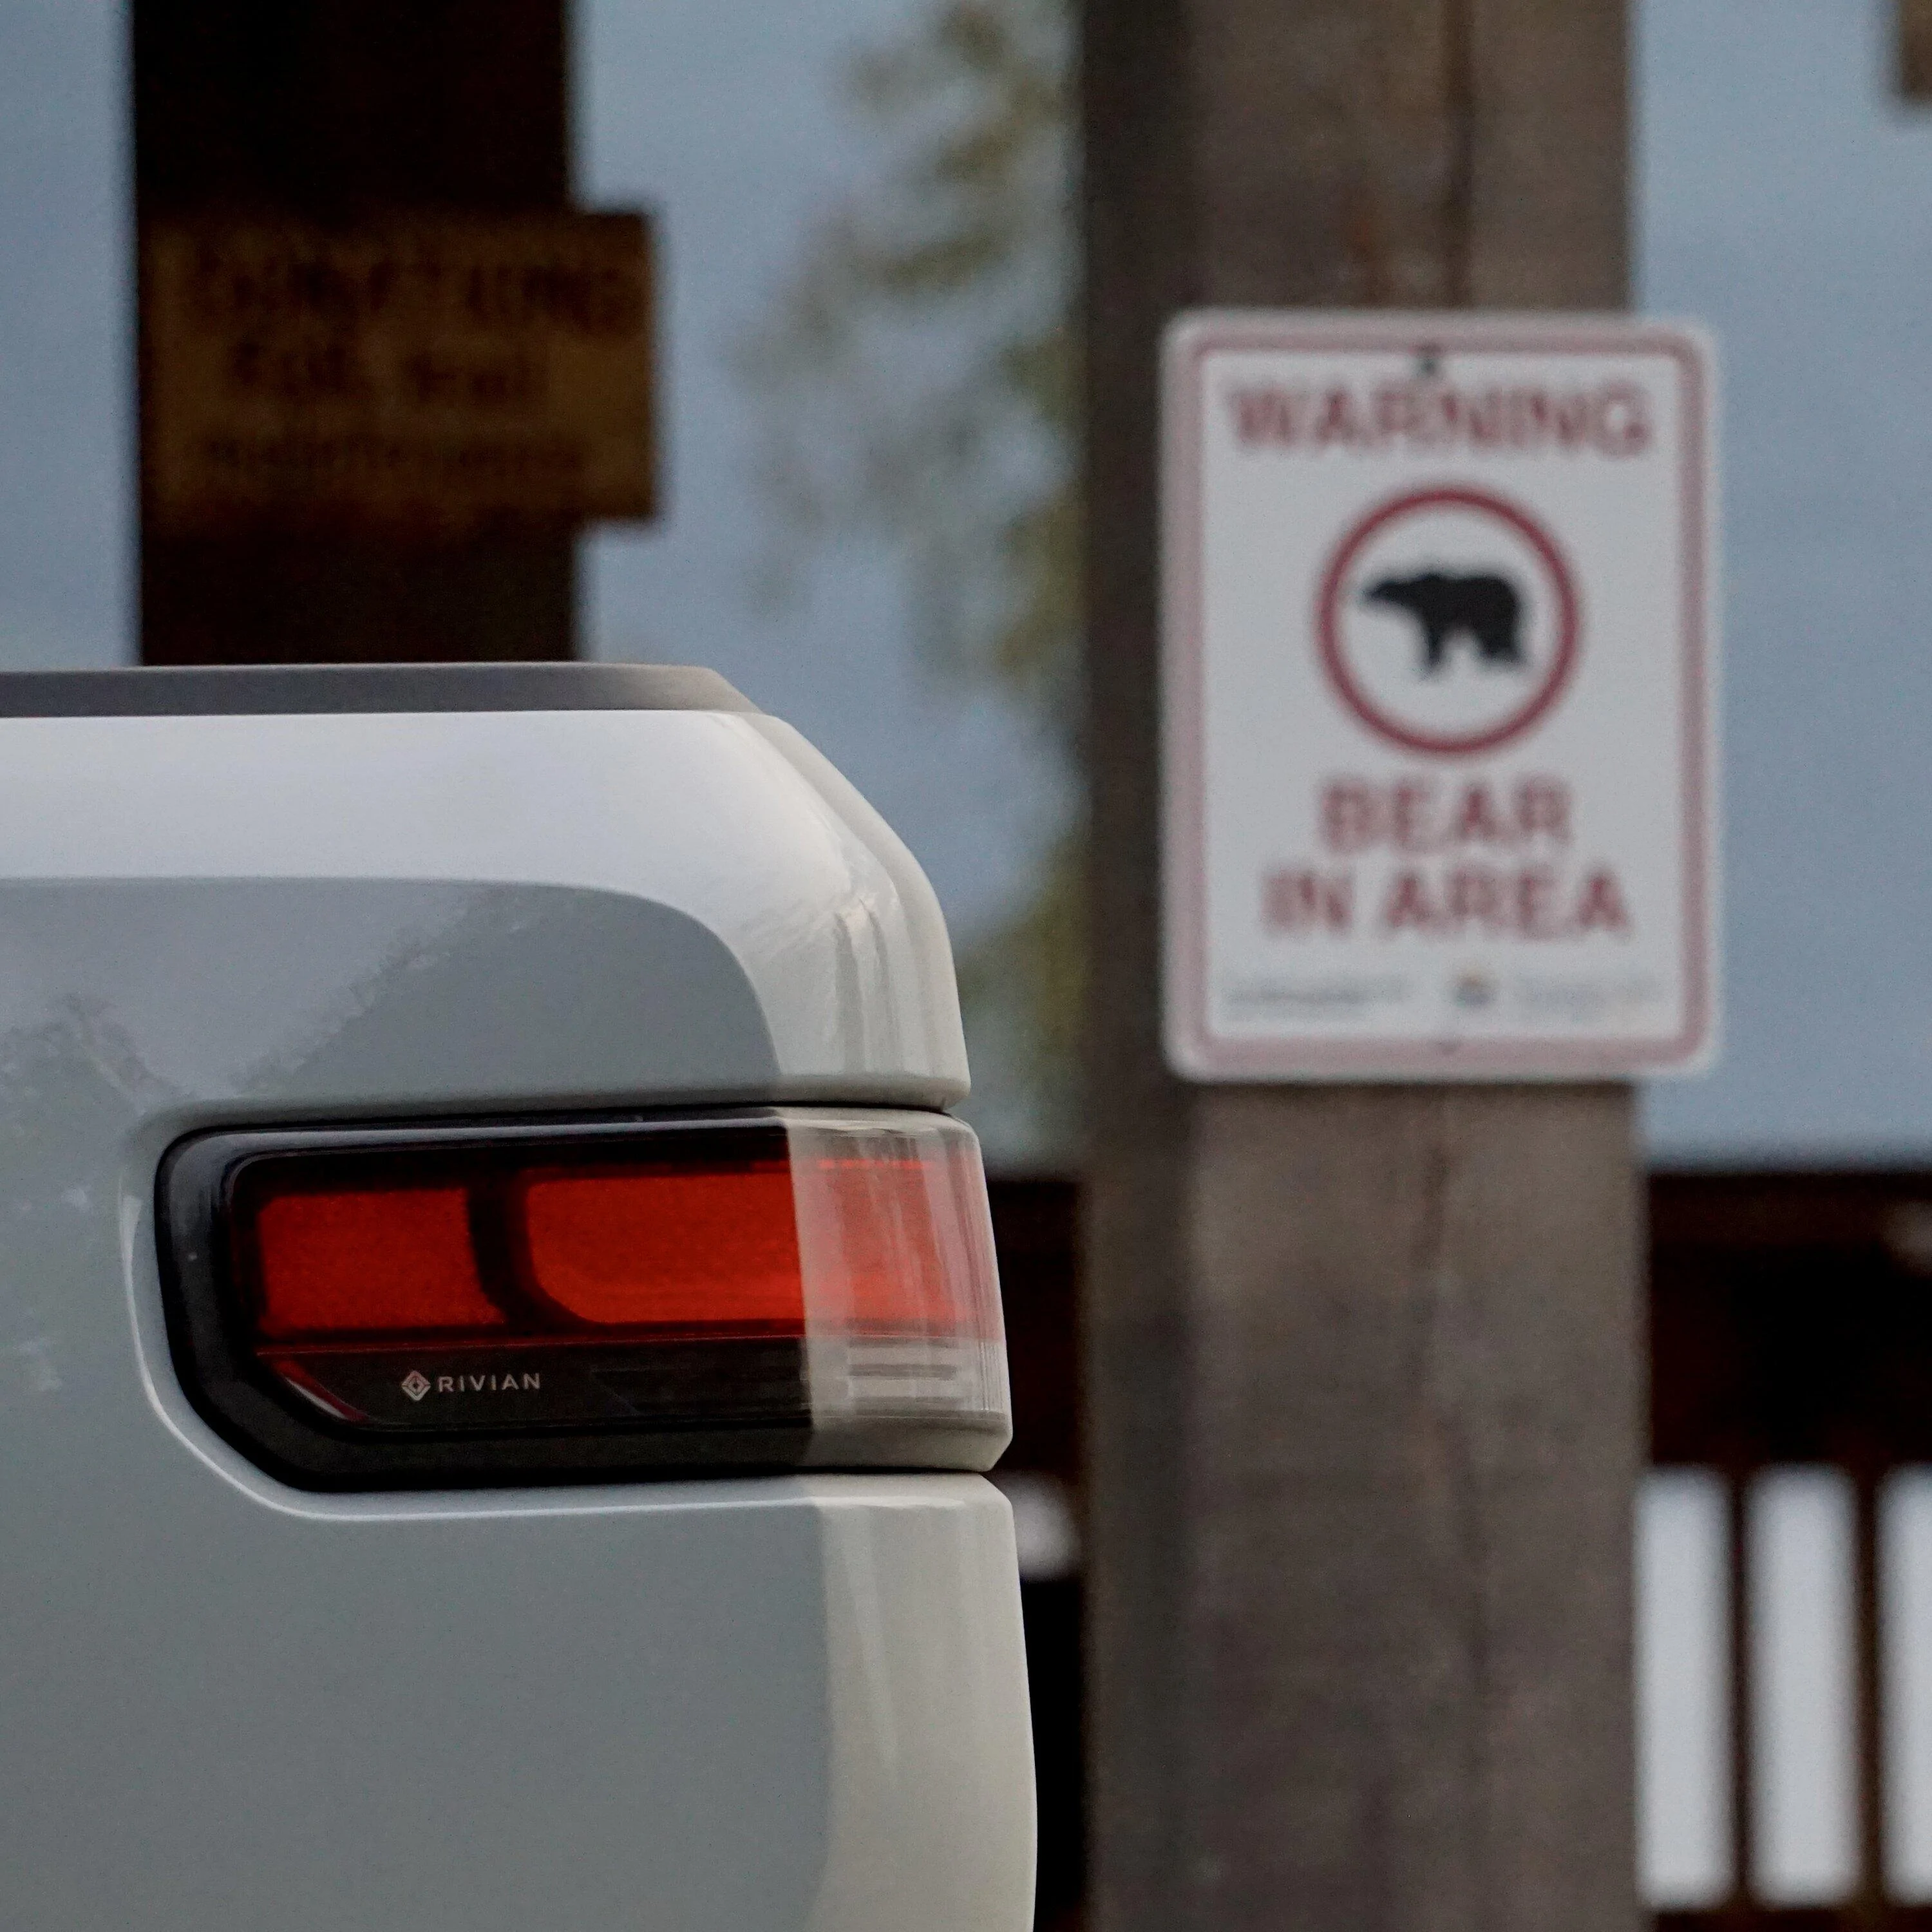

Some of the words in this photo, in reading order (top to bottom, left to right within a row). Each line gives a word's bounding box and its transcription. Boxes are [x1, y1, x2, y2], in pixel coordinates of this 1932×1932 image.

[1231, 383, 1650, 455] WARNING
[1317, 775, 1573, 851] BEAR
[1262, 862, 1354, 934] IN
[1378, 862, 1633, 939] AREA
[437, 1372, 541, 1392] RIVIAN
